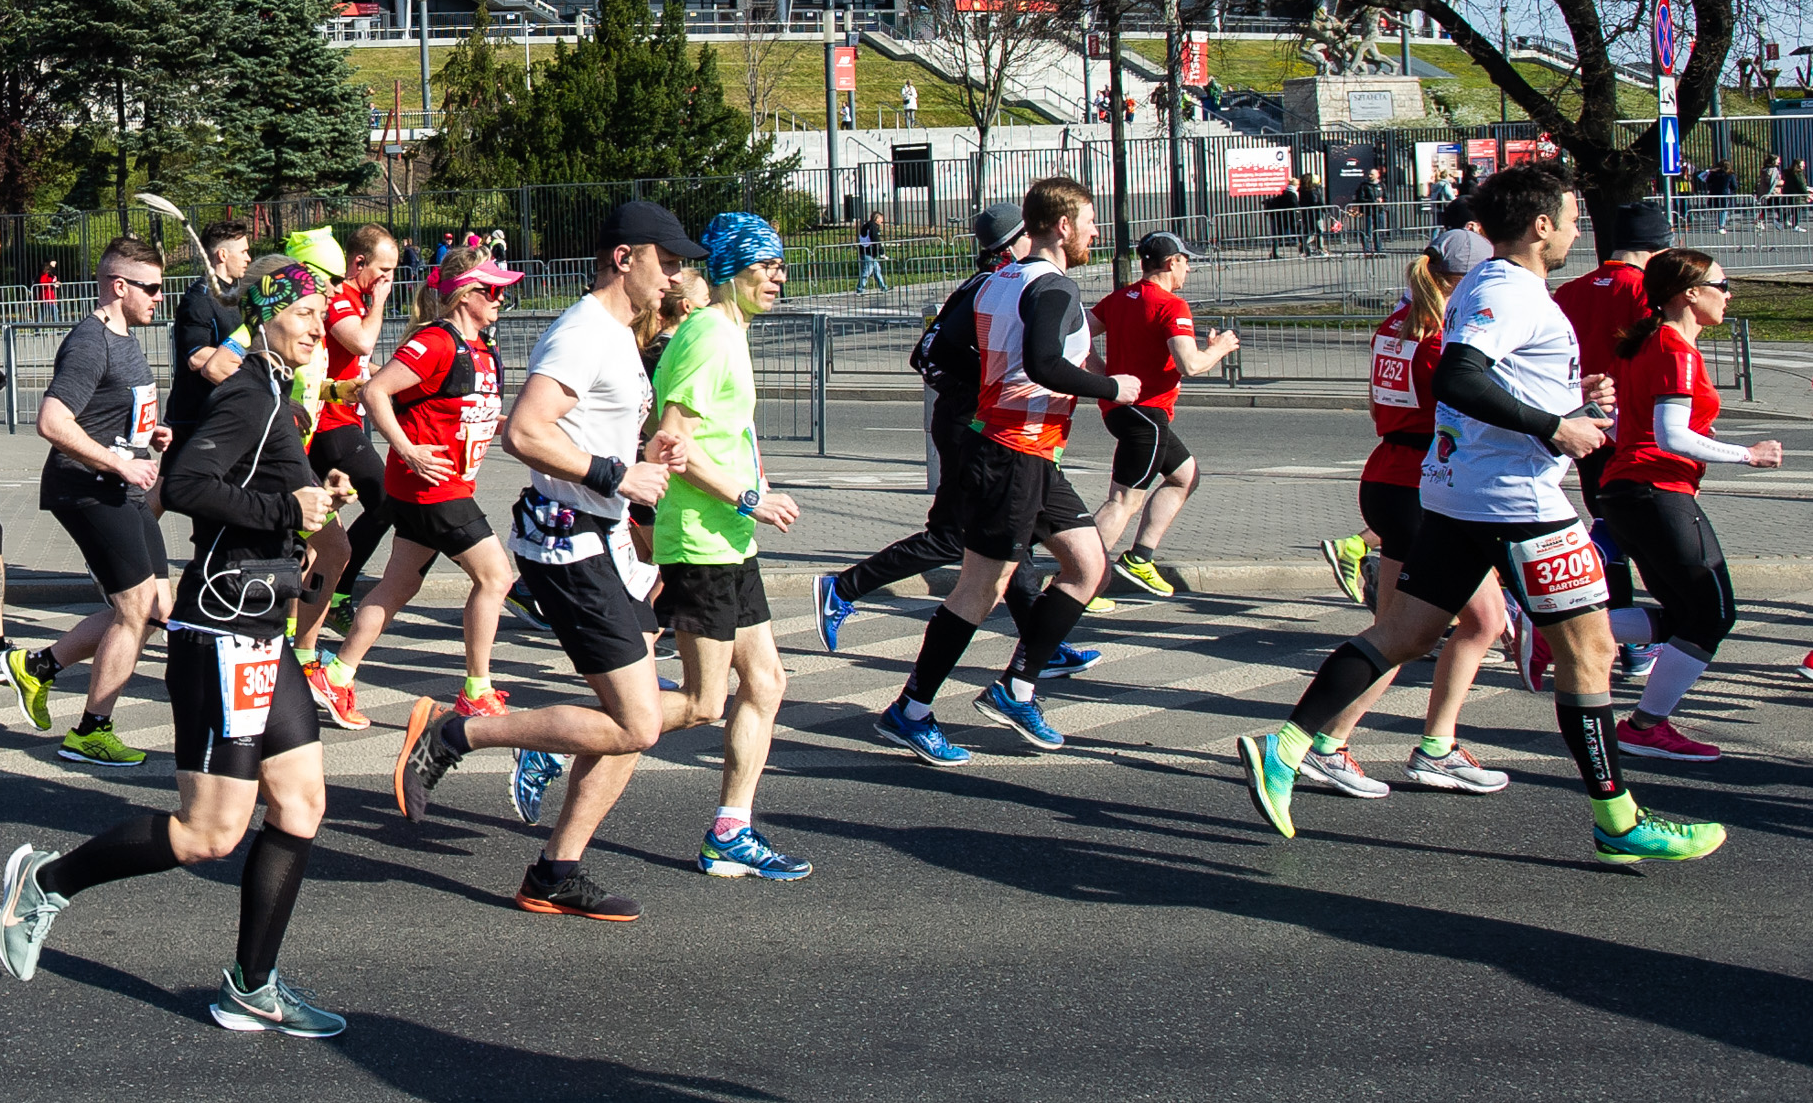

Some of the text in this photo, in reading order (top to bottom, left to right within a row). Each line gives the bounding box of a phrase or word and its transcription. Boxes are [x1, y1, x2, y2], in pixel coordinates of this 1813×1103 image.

[1378, 359, 1404, 382] 1252
[1536, 548, 1595, 585] 3209
[1548, 575, 1591, 593] BARTOSZ
